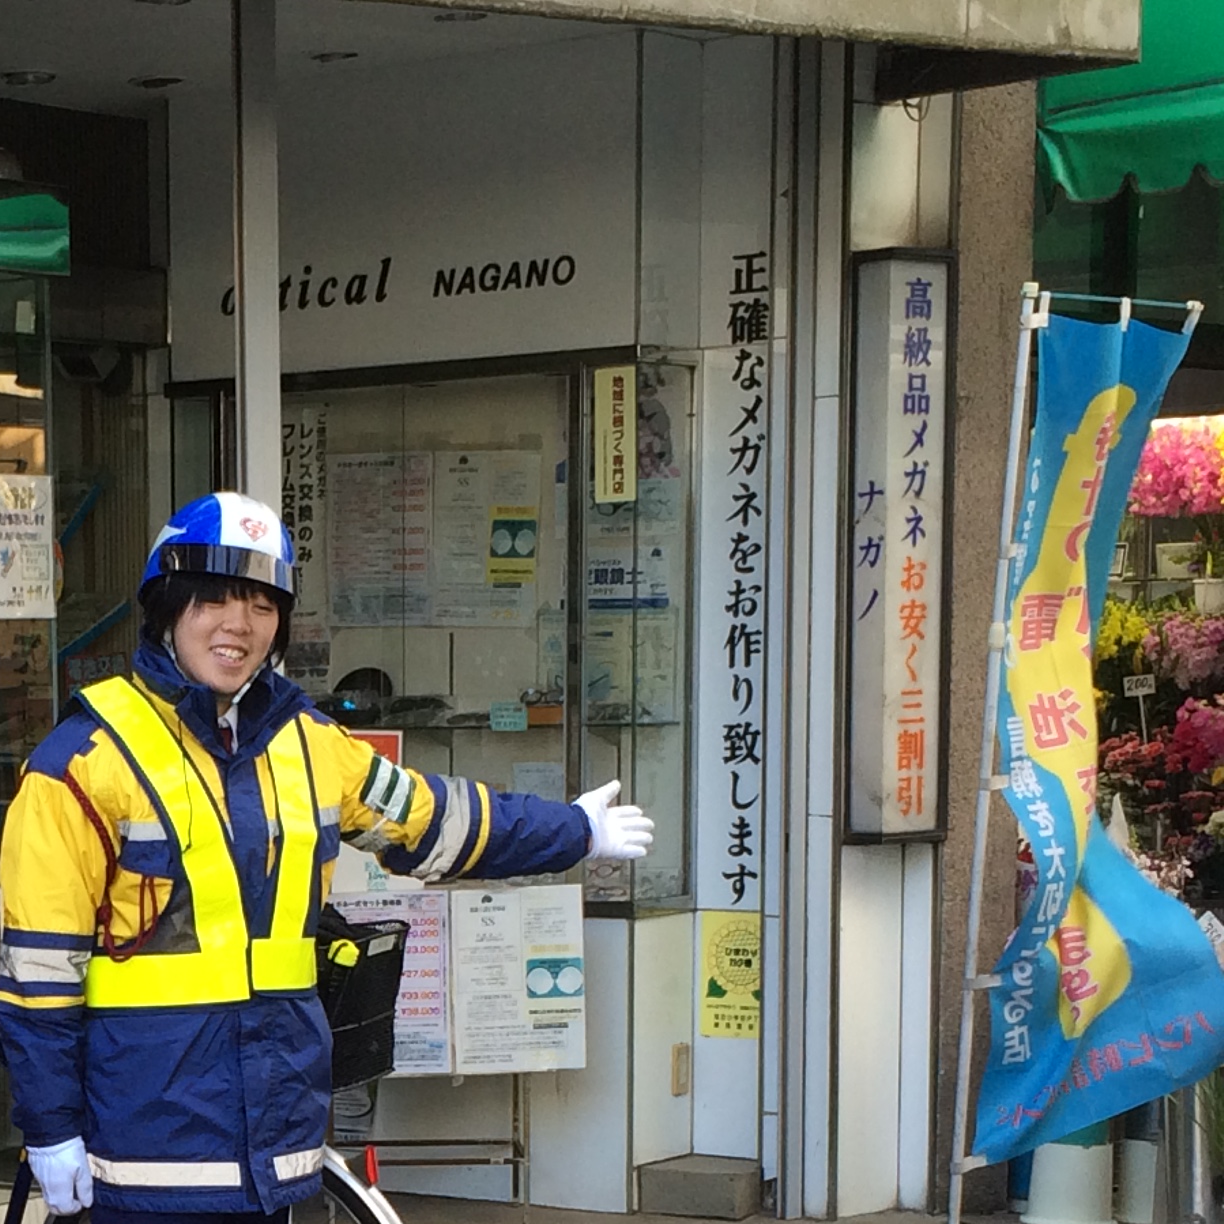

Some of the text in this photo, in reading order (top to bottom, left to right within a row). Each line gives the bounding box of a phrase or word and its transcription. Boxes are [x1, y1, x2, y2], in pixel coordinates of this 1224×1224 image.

[220, 255, 576, 316] otical NAGANO
[298, 423, 313, 562] レンズ交換のみ
[857, 479, 886, 622] ナガノ
[897, 277, 933, 816] 高級品メガネお安く三割引
[722, 250, 769, 906] 正確なメガネをお作り致します
